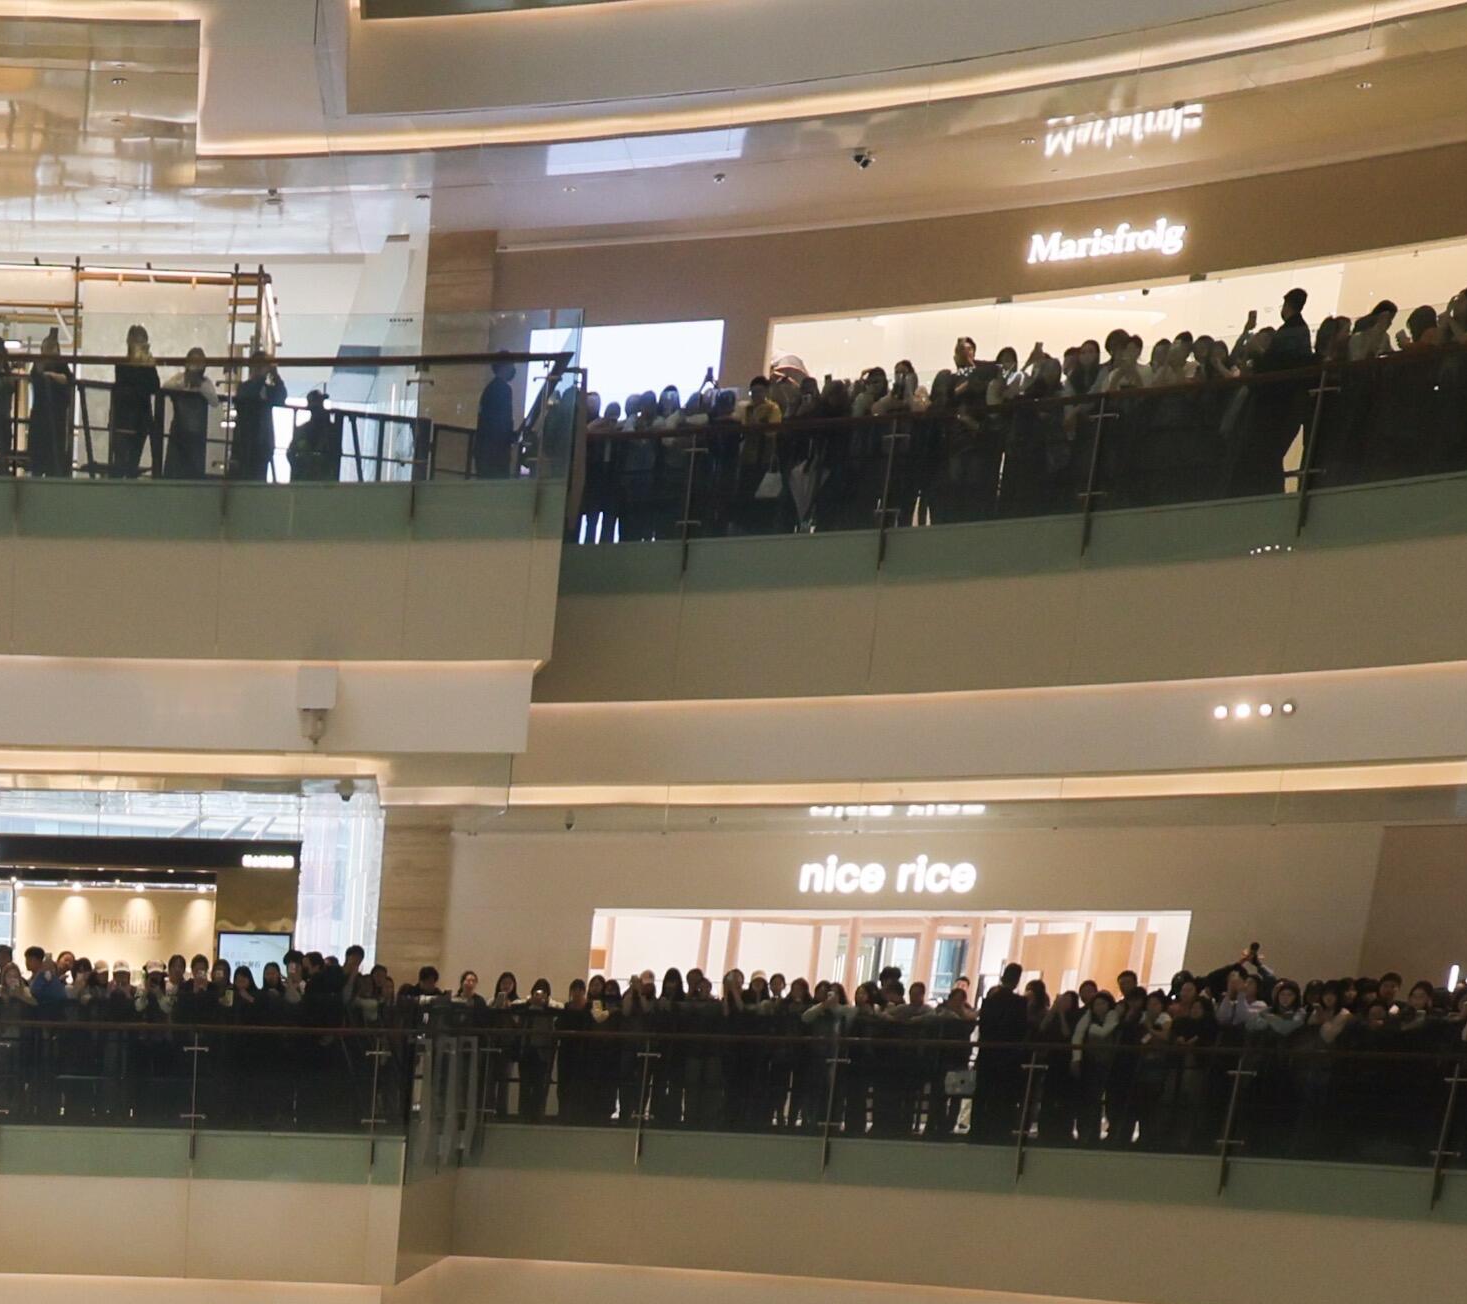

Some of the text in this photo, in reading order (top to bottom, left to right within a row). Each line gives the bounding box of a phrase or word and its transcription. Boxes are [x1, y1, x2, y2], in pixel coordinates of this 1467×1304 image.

[1027, 218, 1187, 264] Marisfrolg
[799, 854, 977, 893] nice rice
